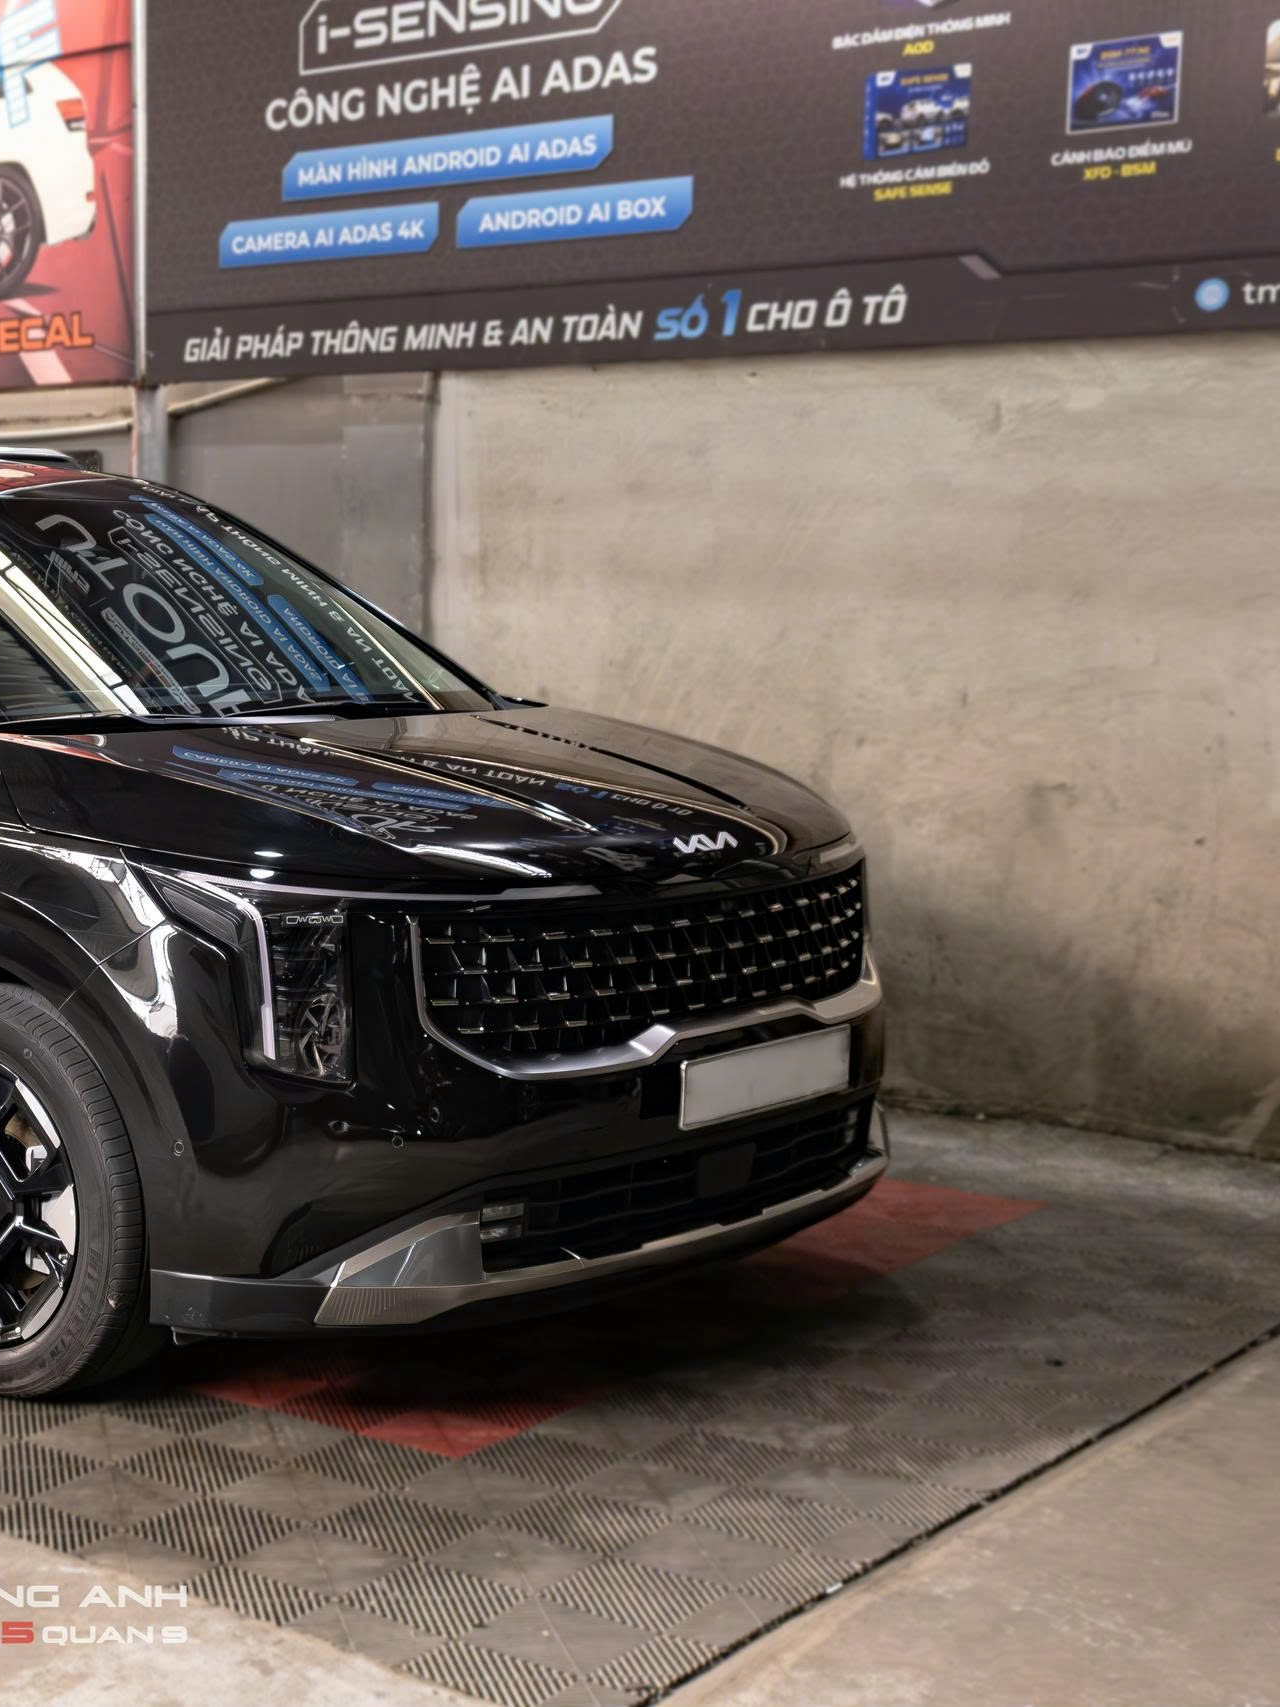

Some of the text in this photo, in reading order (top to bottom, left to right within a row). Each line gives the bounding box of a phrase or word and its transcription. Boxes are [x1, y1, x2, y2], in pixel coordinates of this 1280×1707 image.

[265, 46, 658, 131] CÔNG NGHỆ AI ADAS
[297, 134, 597, 188] MÀN HÌNH ANDROID AI ADAS
[231, 219, 425, 254] CAMERA AI ADAS 4K
[479, 196, 666, 233] ANDROID AI BOX
[184, 283, 908, 363] GIẢI PHÁP THÔNG MINH & AN TOÀN SỐ 1 CHO Ô TÔ
